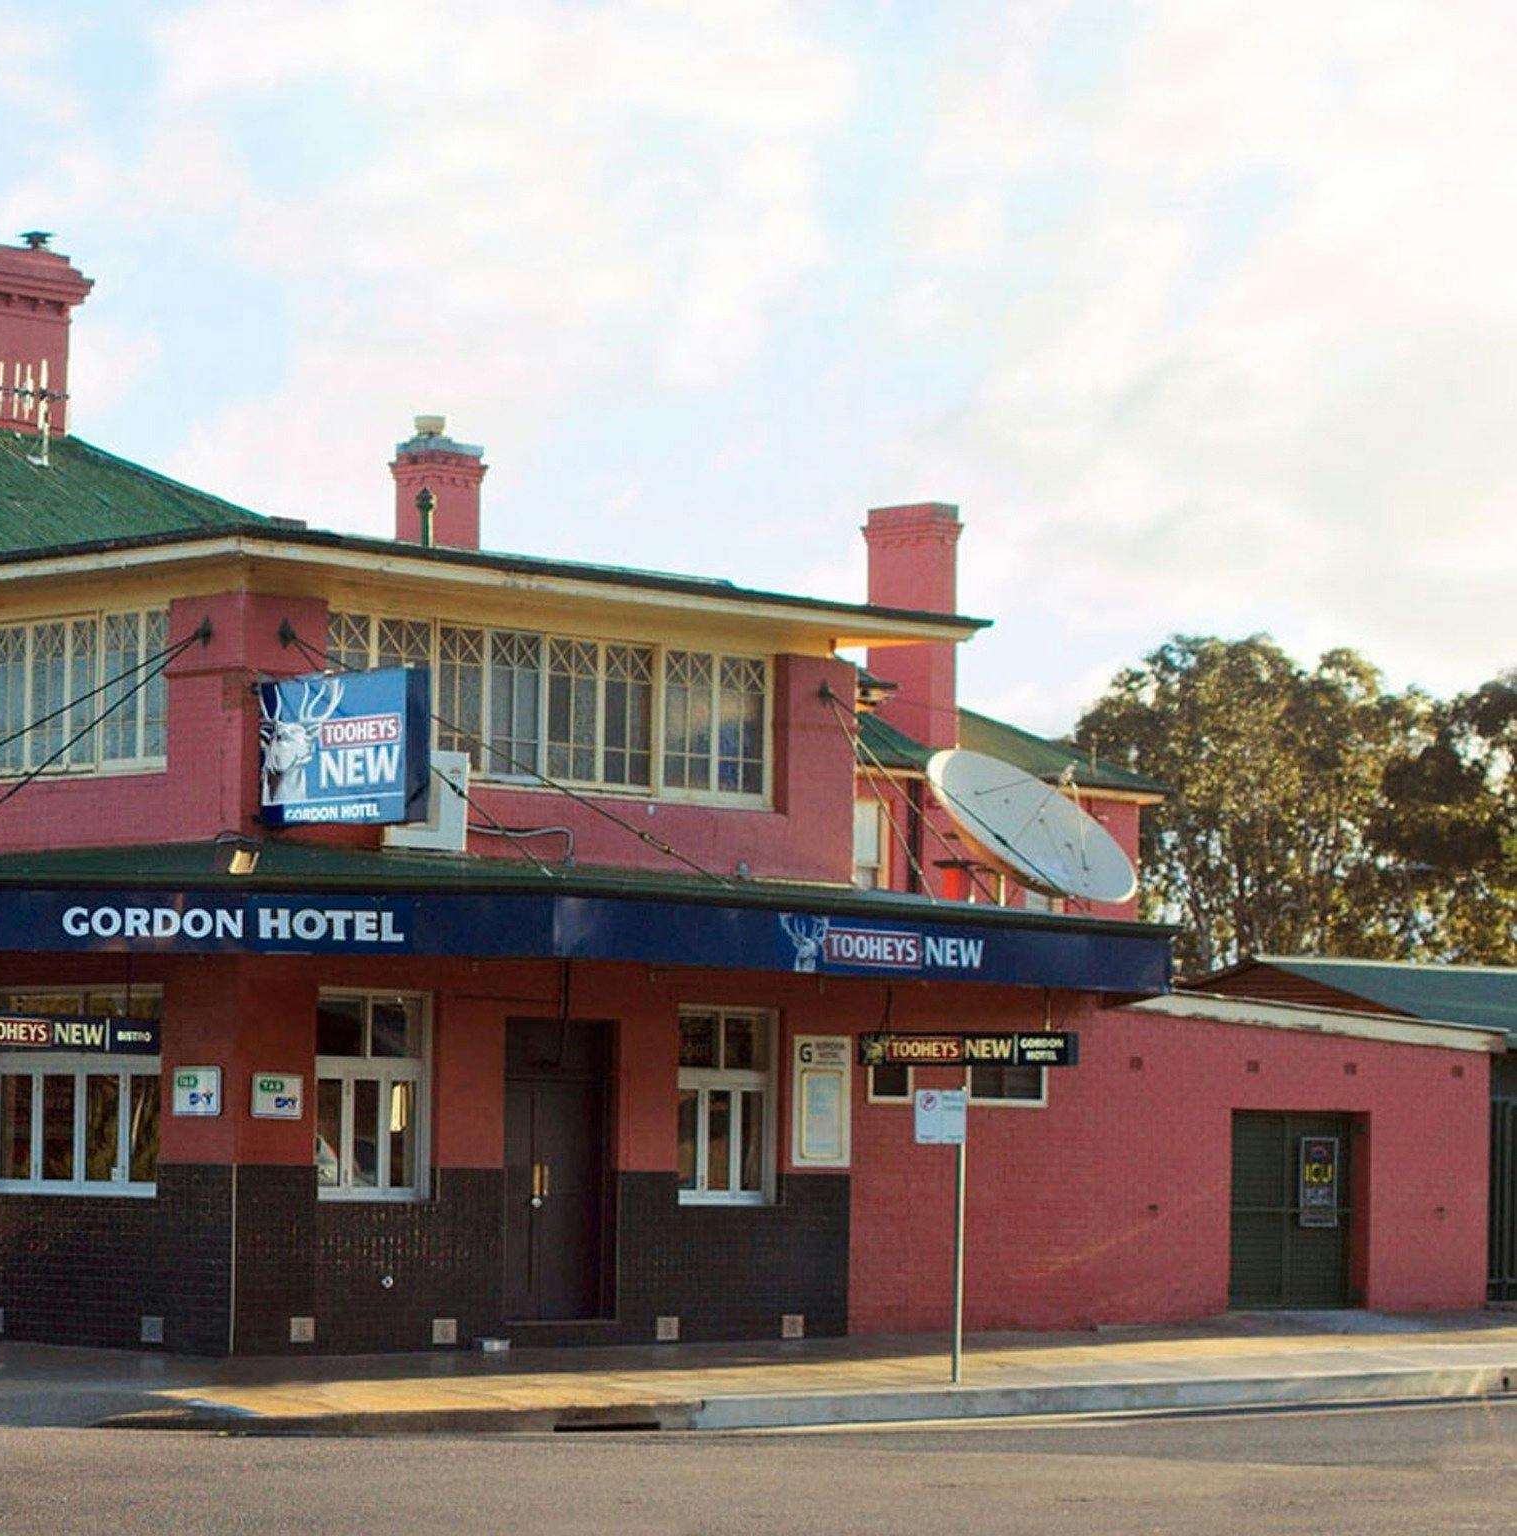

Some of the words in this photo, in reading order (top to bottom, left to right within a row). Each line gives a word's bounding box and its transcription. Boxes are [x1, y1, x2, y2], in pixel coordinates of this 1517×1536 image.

[325, 718, 397, 744] TOOHEYS
[320, 746, 400, 790] NEW
[285, 805, 339, 821] GORDON
[341, 803, 380, 818] HOTEL
[62, 906, 244, 938] GORDON
[258, 907, 405, 942] HOTEL
[829, 934, 917, 962] TOOHEYS
[925, 937, 984, 968] NEW
[54, 1023, 104, 1045] NEW
[117, 1031, 152, 1042] BISTRO
[1020, 1038, 1064, 1048] GORDON
[800, 1043, 813, 1063] G
[891, 1041, 959, 1057] TOOHEYS
[965, 1039, 1013, 1059] NEW
[1026, 1050, 1058, 1061] HOTEL
